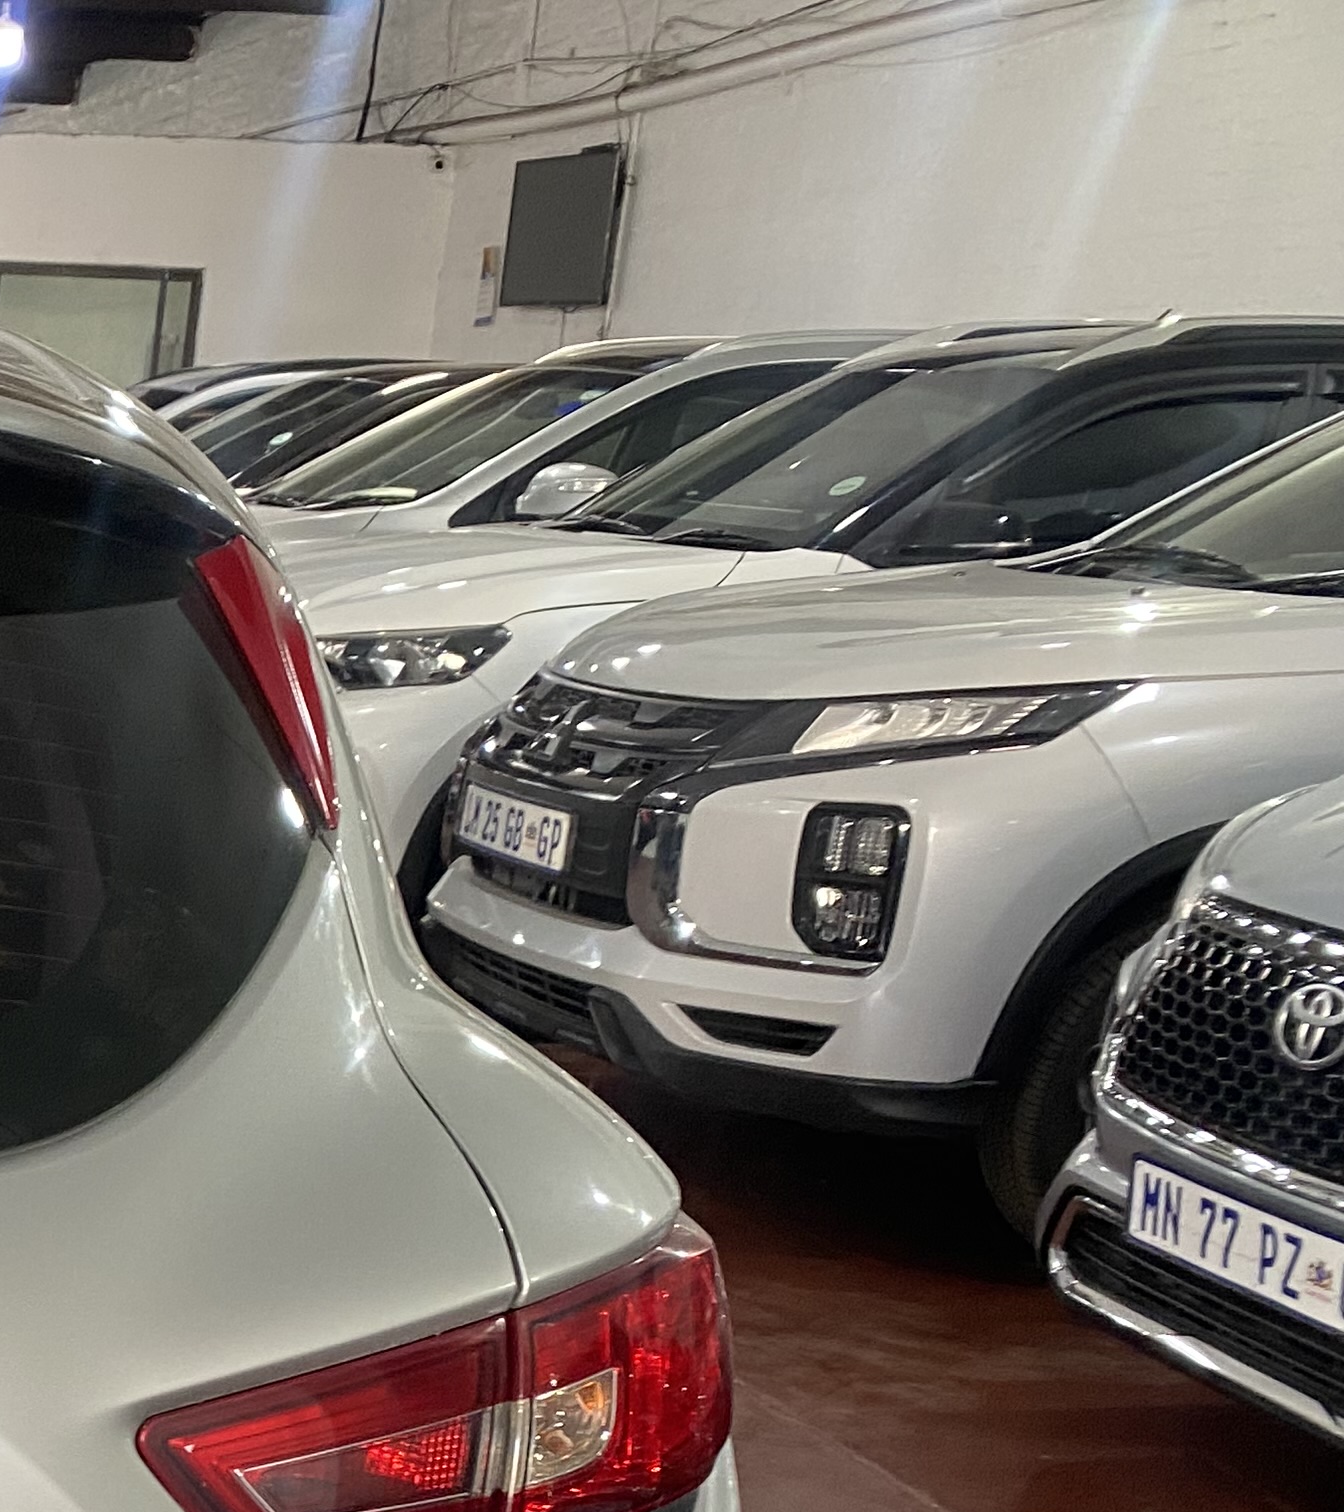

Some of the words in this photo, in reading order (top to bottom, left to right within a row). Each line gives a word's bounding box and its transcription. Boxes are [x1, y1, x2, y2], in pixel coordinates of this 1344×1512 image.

[481, 800, 502, 843] 25
[503, 807, 524, 852] GB
[537, 816, 562, 865] GP
[1141, 1172, 1183, 1246] MN
[1199, 1197, 1240, 1269] 77
[1258, 1222, 1303, 1300] PZ
